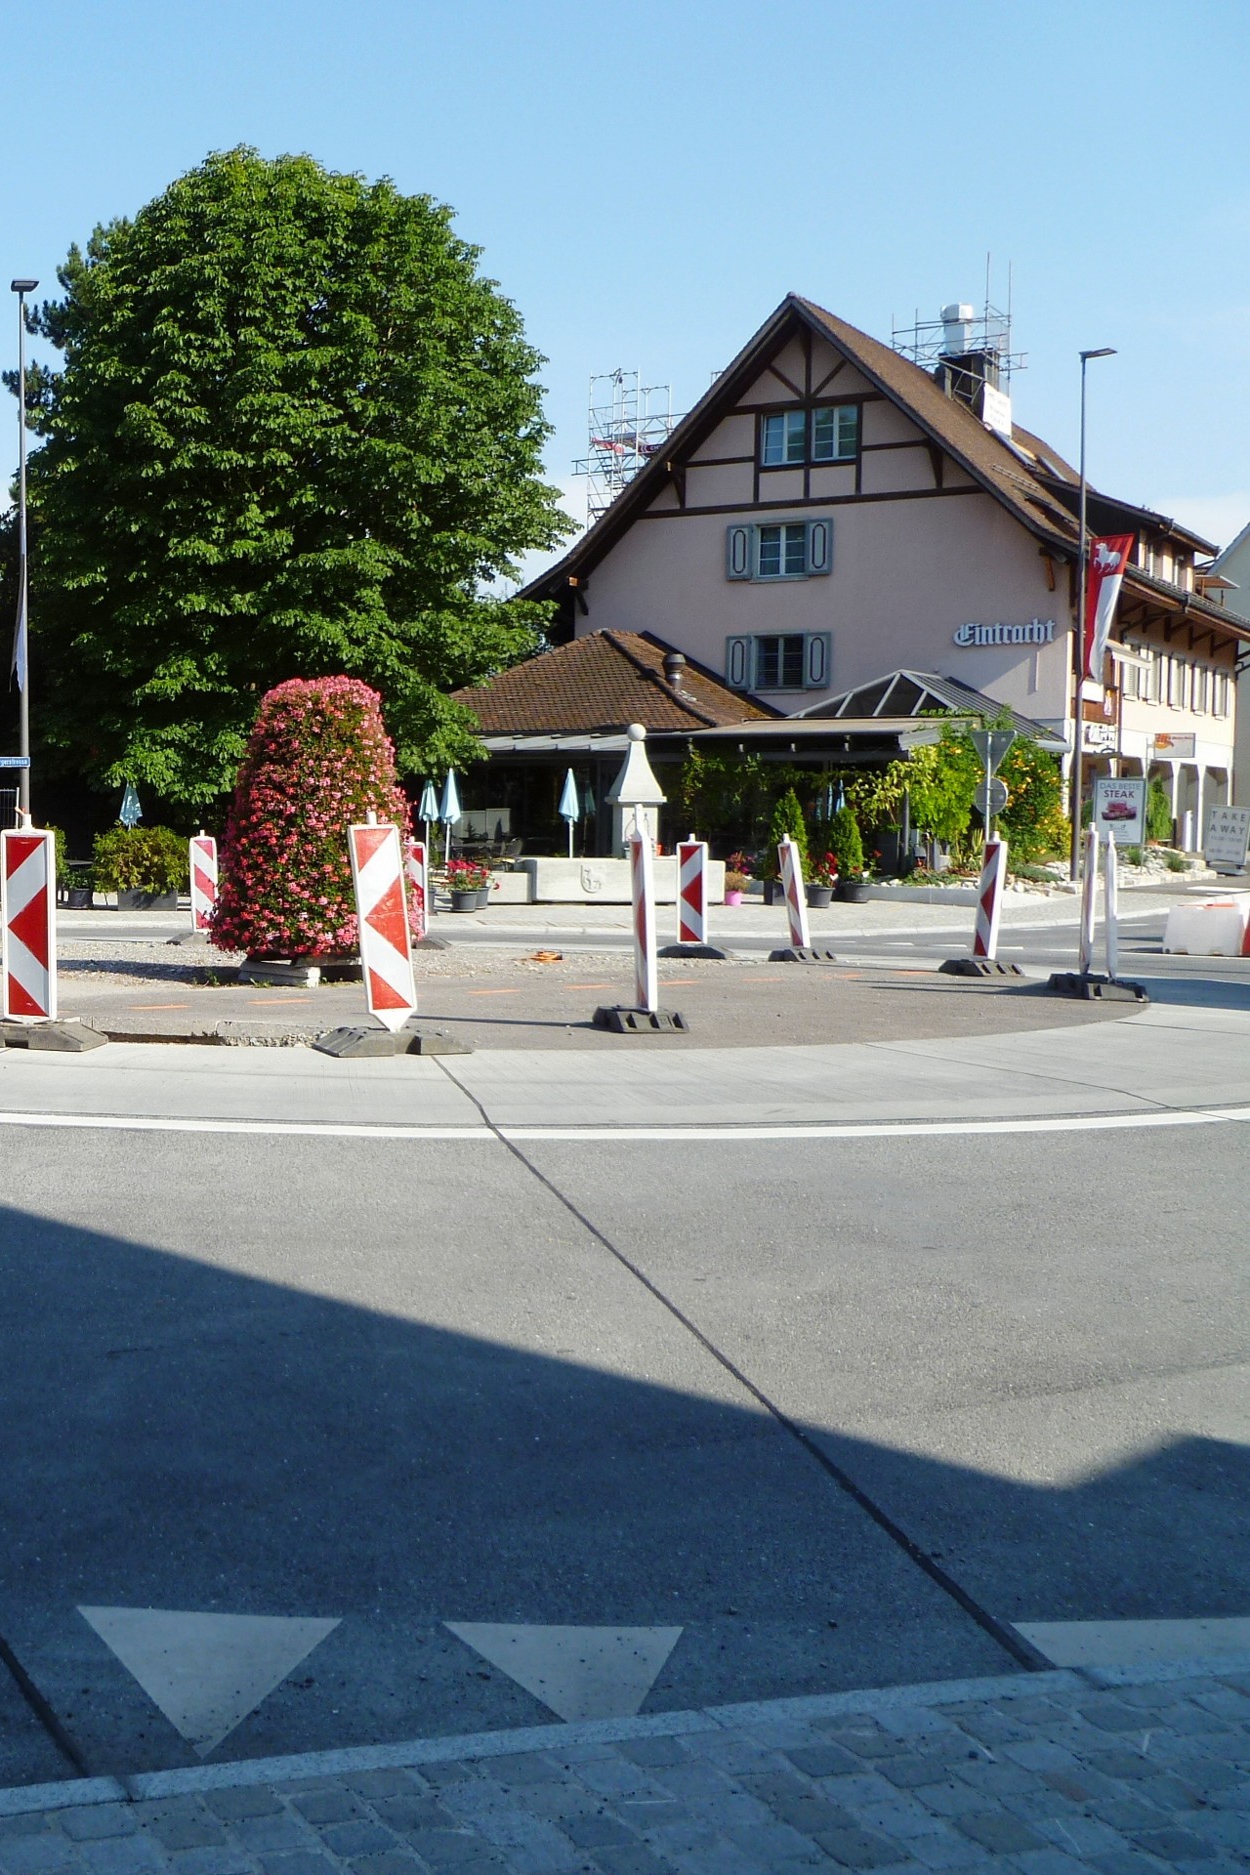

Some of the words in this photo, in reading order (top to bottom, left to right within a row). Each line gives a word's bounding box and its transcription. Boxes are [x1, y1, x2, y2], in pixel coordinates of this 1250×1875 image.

[953, 618, 1055, 647] Eintracht
[1100, 782, 1117, 790] DAS
[1121, 782, 1142, 790] BESTE
[1103, 789, 1135, 799] STEAK
[1212, 810, 1246, 822] TAKE
[1210, 824, 1246, 835] AWAY
